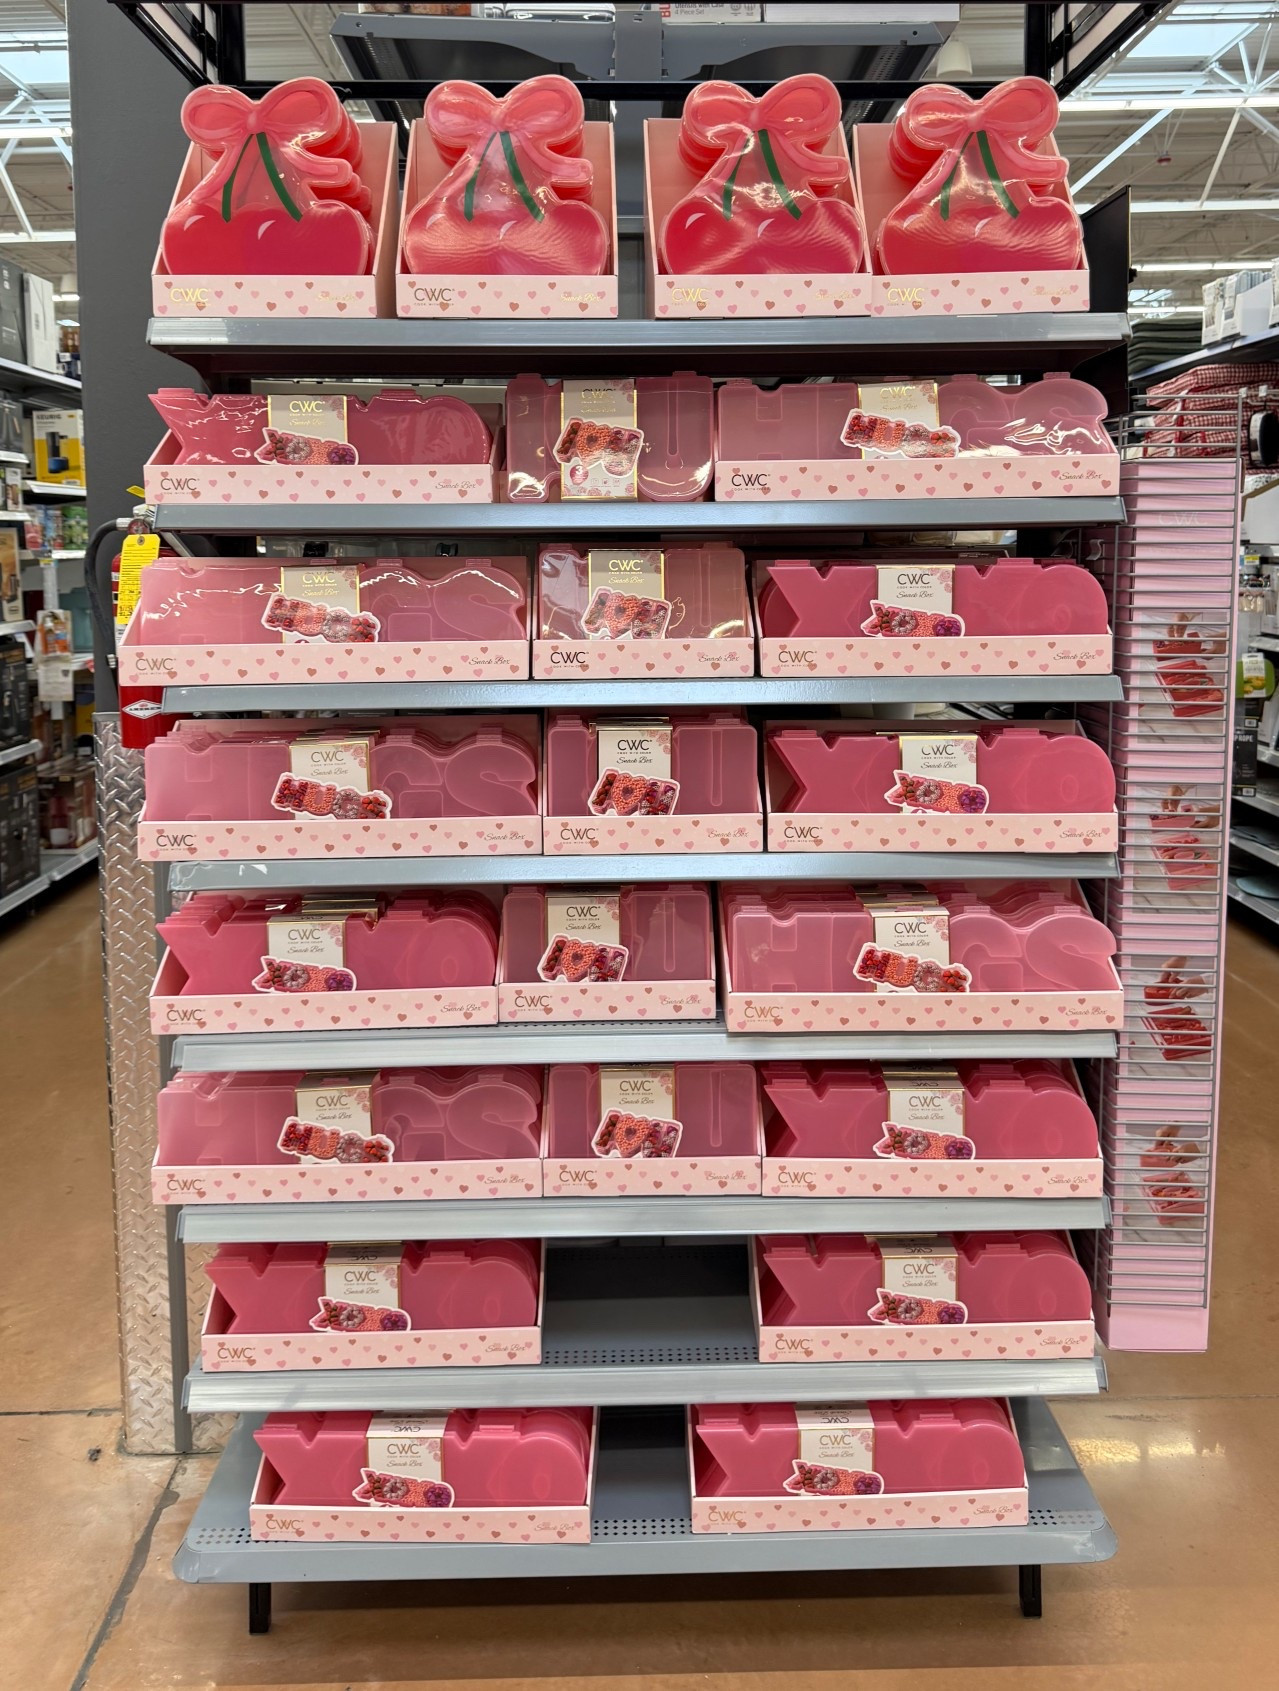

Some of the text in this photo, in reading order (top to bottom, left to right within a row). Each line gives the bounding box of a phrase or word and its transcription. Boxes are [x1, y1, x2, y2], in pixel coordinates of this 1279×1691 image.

[170, 288, 209, 302] CWC
[414, 288, 452, 302] CWC
[672, 288, 710, 302] CWC
[887, 288, 924, 302] CWC
[880, 386, 912, 400] CWC
[289, 400, 324, 412] CWC
[732, 474, 769, 487] CWC
[1059, 471, 1103, 481] Snack Box
[161, 478, 198, 491] CWC
[460, 480, 476, 489] Box
[608, 560, 642, 572] CWC
[302, 572, 336, 584] CWC
[608, 576, 645, 585] Snack Box
[898, 574, 931, 586] CWC
[896, 590, 934, 599] Snack Box
[468, 656, 512, 666] Snack Box
[550, 652, 586, 664] CWC
[778, 650, 816, 663] CWC
[1053, 652, 1096, 661] Snack Box
[136, 658, 174, 671] CWC
[618, 739, 650, 752] CWC
[922, 744, 954, 756] CWC
[310, 750, 344, 763] CWC
[617, 755, 653, 764] Snack Box
[945, 760, 959, 768] Box
[484, 832, 526, 841] Snack Box
[560, 828, 596, 841] CWC
[708, 830, 750, 840] Snack Box
[784, 826, 822, 839] CWC
[1059, 830, 1102, 839] Snack Box
[156, 834, 194, 848] CWC
[566, 906, 600, 918] CWC
[566, 922, 602, 932] Snack Box
[894, 922, 927, 934] CWC
[288, 928, 321, 941] CWC
[894, 939, 930, 948] Snack Box
[440, 1003, 481, 1012] Snack Box
[514, 995, 551, 1008] CWC
[166, 1009, 204, 1022] CWC
[744, 1006, 781, 1018] CWC
[1090, 1006, 1108, 1016] Box
[620, 1080, 652, 1092] CWC
[316, 1094, 349, 1108] CWC
[909, 1096, 942, 1108] CWC
[510, 1176, 526, 1184] Box
[559, 1170, 596, 1182] CWC
[778, 1172, 814, 1184] CWC
[1048, 1176, 1088, 1184] Snack Box
[167, 1179, 204, 1192] CWC
[903, 1264, 935, 1274] CWC
[344, 1270, 376, 1282] CWC
[775, 1338, 810, 1351] CWC
[218, 1348, 253, 1360] CWC
[820, 1434, 852, 1446] CWC
[386, 1444, 420, 1455] CWC
[708, 1510, 744, 1522] CWC
[266, 1520, 302, 1530] CWC
